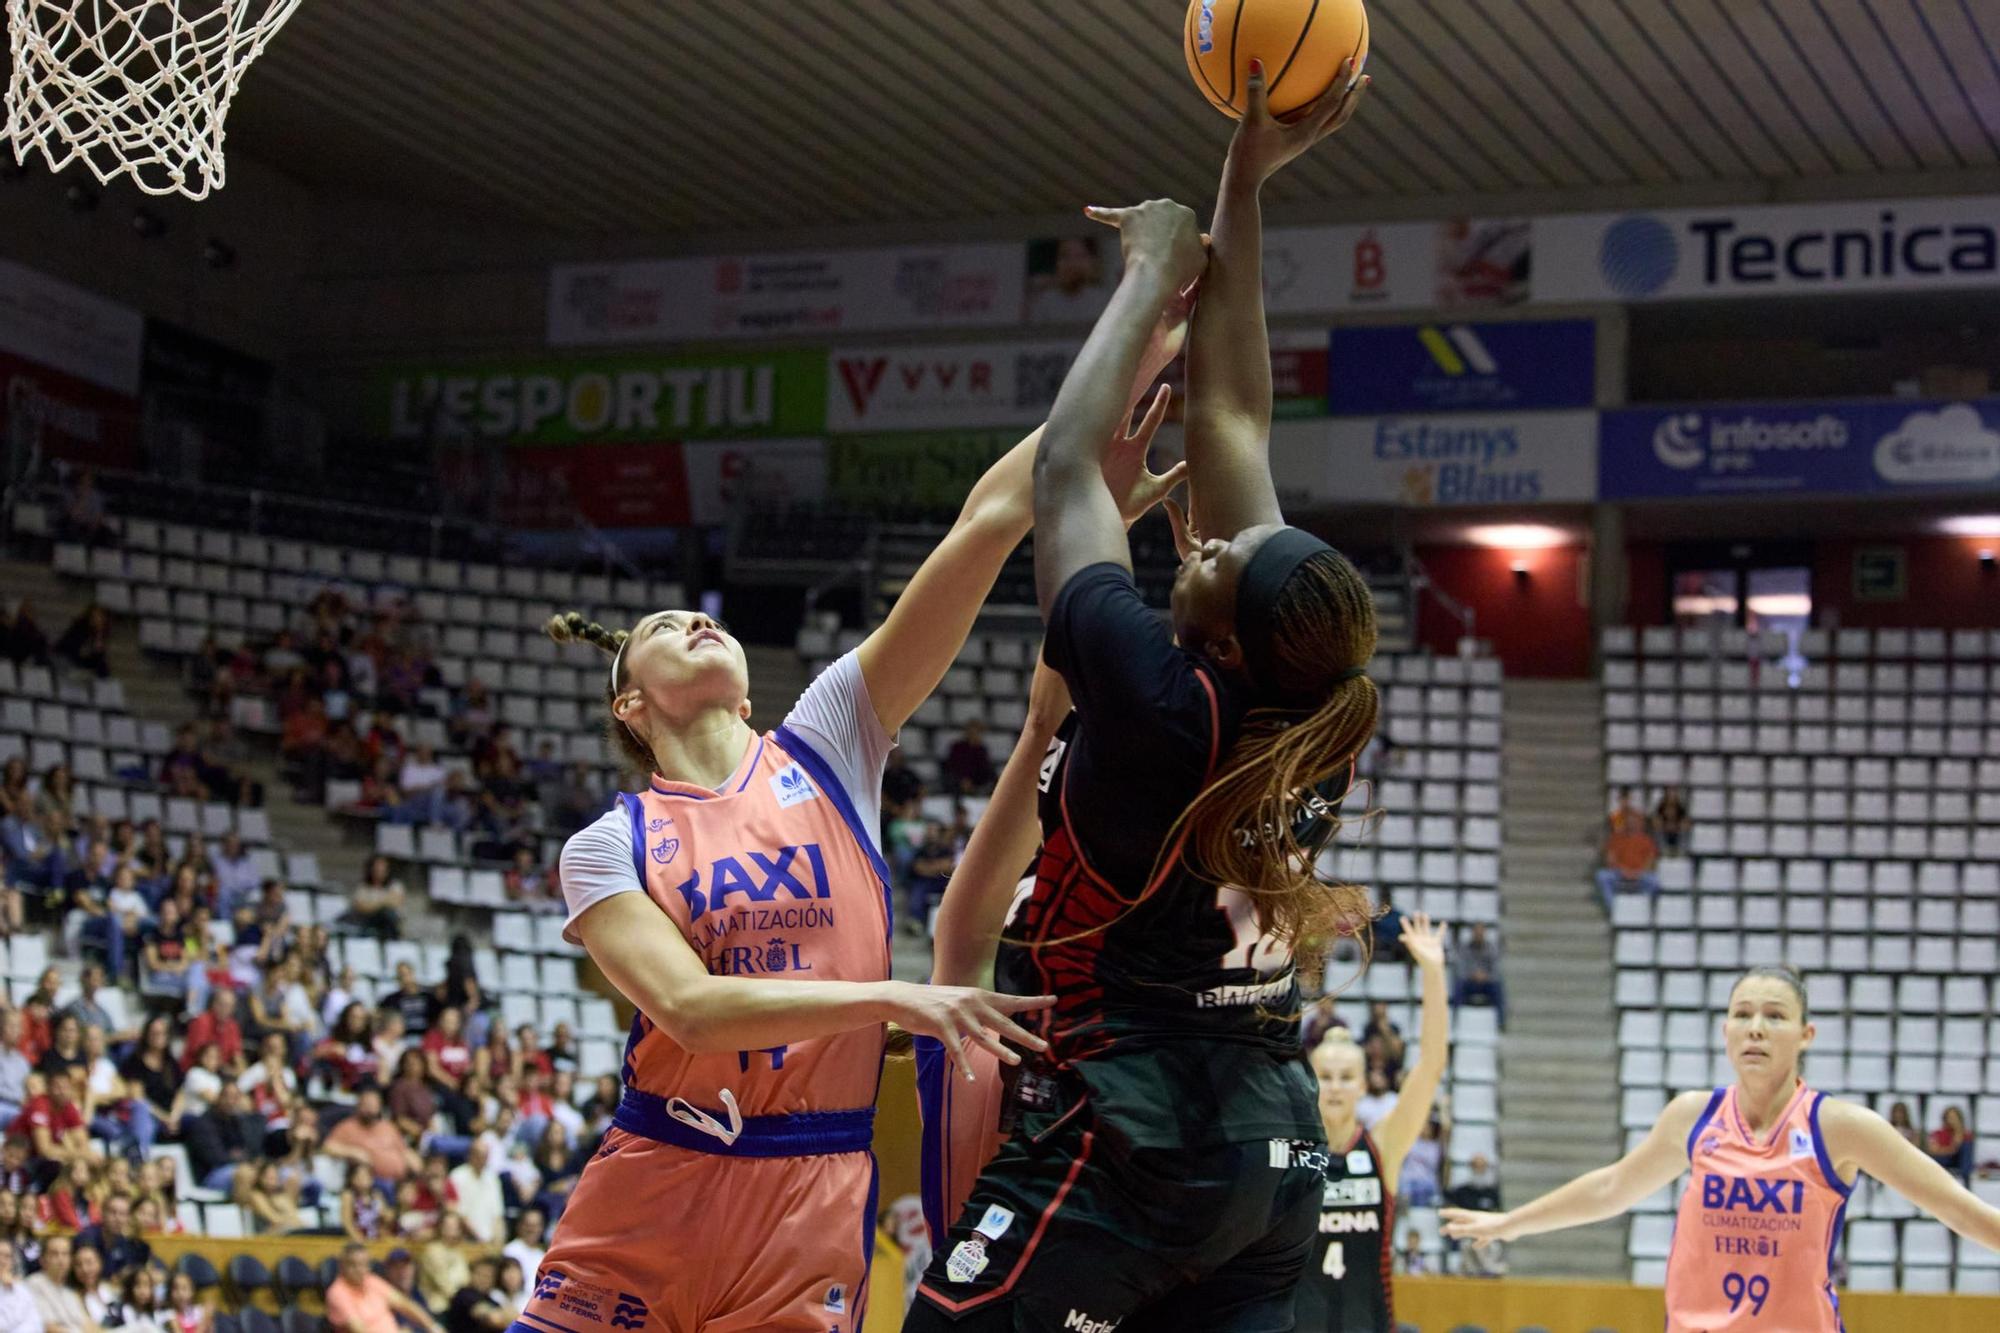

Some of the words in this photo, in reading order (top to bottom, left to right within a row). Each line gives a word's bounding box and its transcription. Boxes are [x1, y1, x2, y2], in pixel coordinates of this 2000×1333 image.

[1689, 210, 1998, 284] Tecnica
[900, 360, 993, 393] VVR
[391, 364, 775, 438] L'ESPORTIU
[1374, 420, 1520, 467] Estanys
[1710, 414, 1848, 450] infosoft
[1437, 462, 1542, 504] Blaus
[676, 843, 831, 922] BAXI
[1702, 1173, 1804, 1214] BAXI
[1702, 1213, 1802, 1232] CLIMATIZACIÓN
[1322, 1240, 1347, 1280] 4
[559, 1302, 571, 1313] DE
[571, 1306, 604, 1323] FERROL
[562, 1294, 599, 1311] TURISMO
[1722, 1272, 1770, 1318] 99
